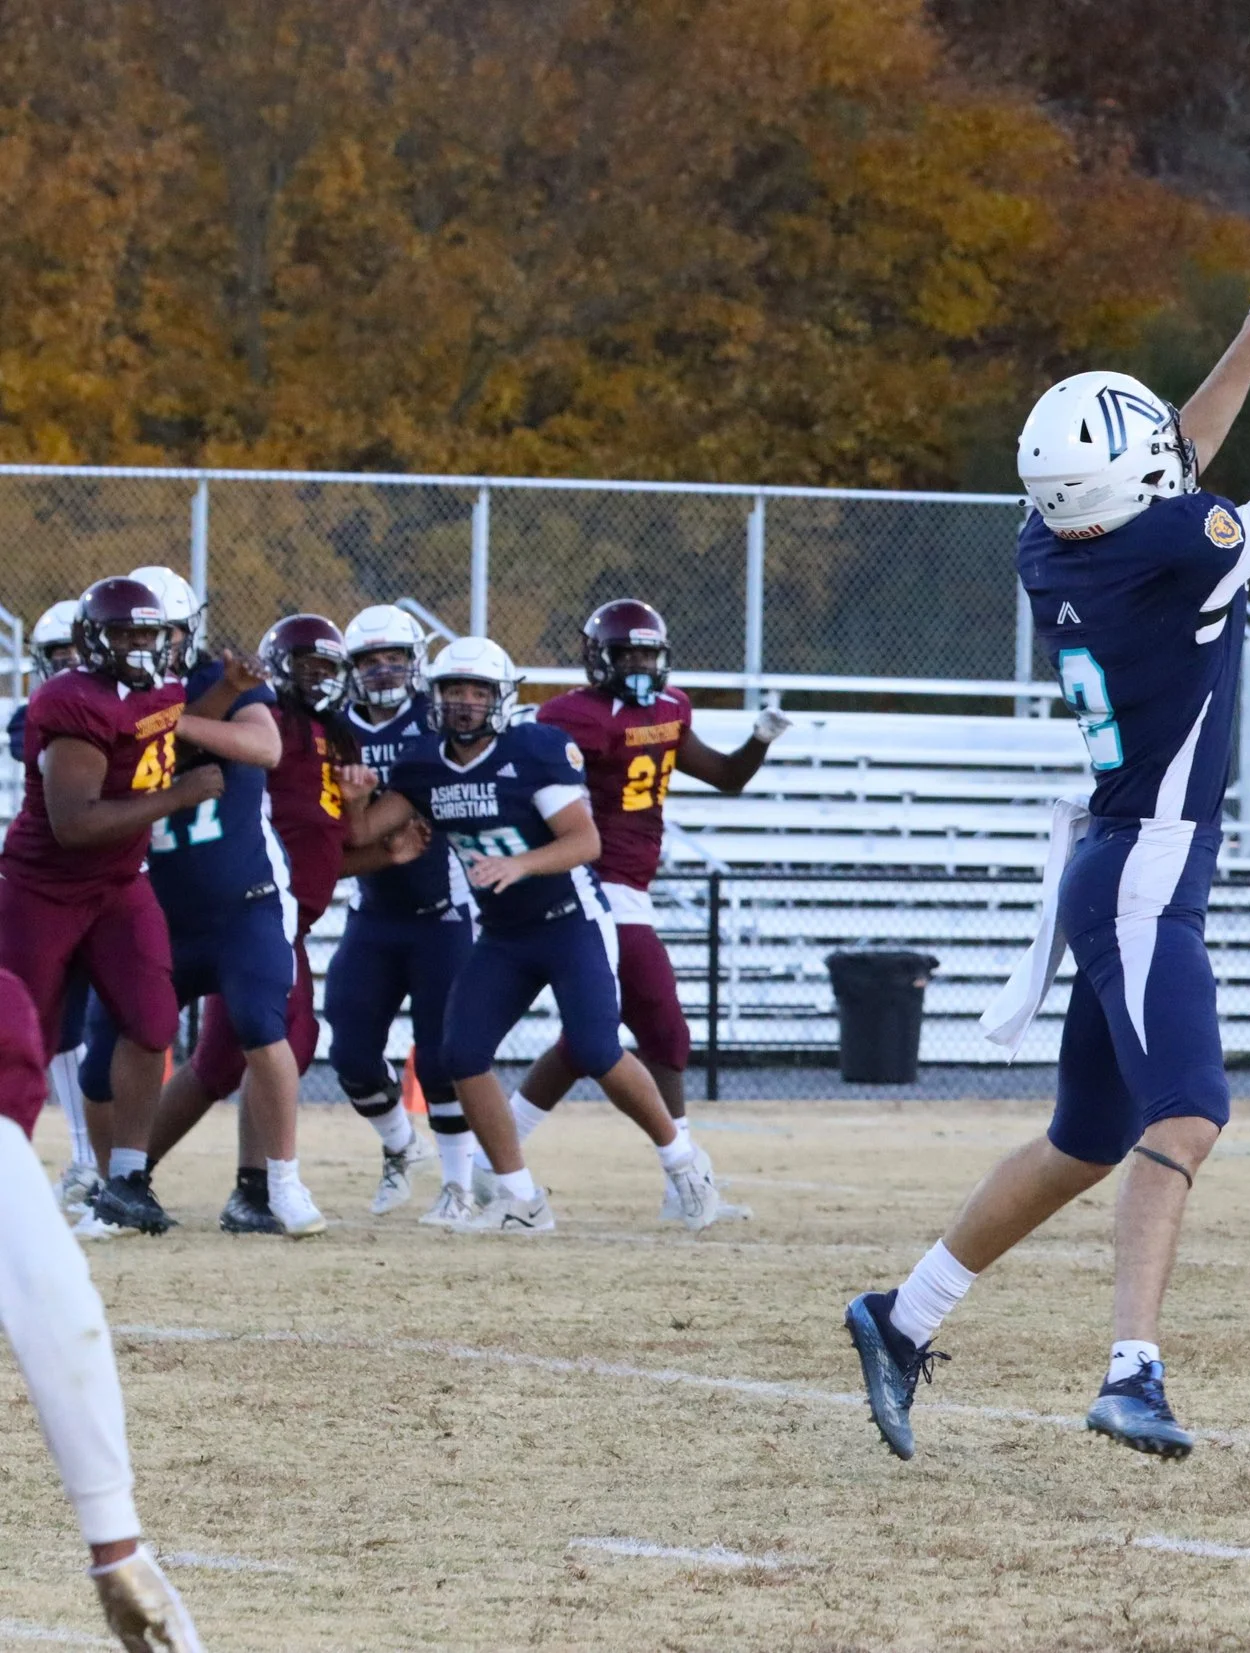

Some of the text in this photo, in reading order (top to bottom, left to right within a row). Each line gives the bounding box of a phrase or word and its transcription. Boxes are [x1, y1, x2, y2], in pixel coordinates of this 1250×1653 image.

[1058, 647, 1124, 770] 2
[430, 782, 497, 803] ASHEVILLE
[430, 799, 500, 820] CHRISTIAN
